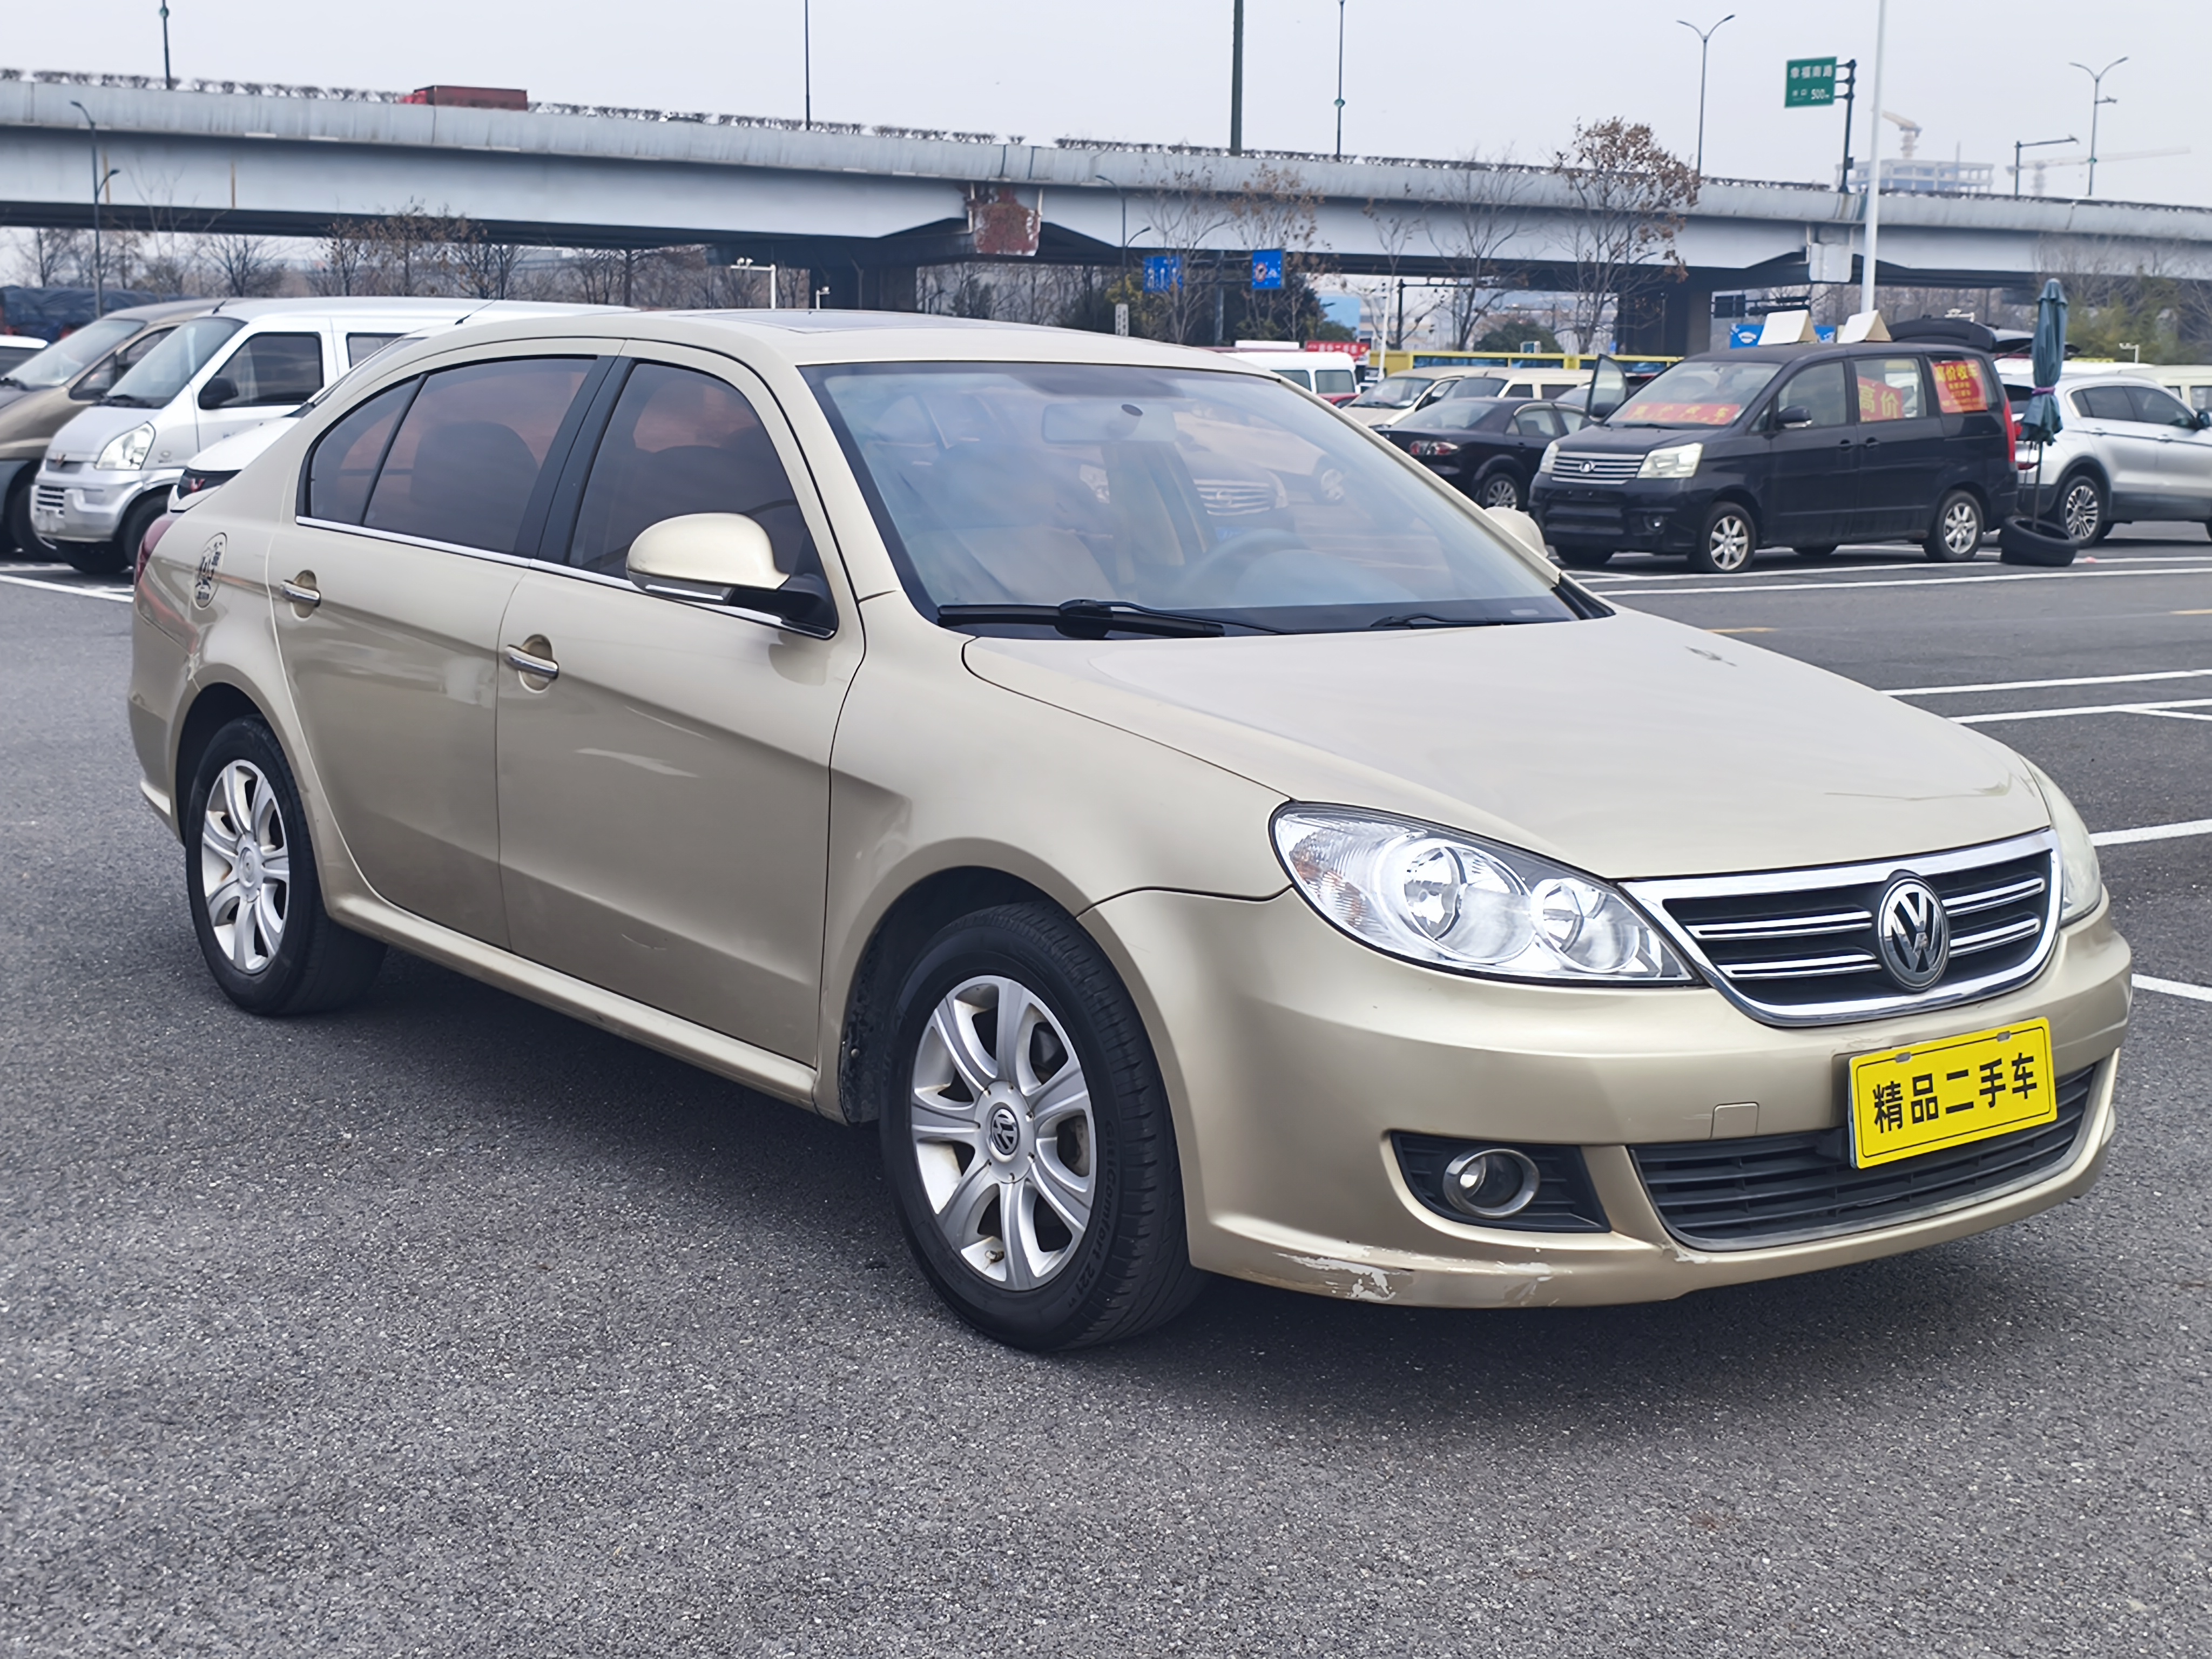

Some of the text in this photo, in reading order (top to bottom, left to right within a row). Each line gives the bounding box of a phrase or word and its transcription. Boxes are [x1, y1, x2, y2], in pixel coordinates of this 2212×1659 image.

[1935, 363, 1979, 382] 高价收车
[1858, 385, 1899, 420] 高价
[1872, 1052, 2038, 1134] 精品二手车
[1075, 1262, 1096, 1294] 221
